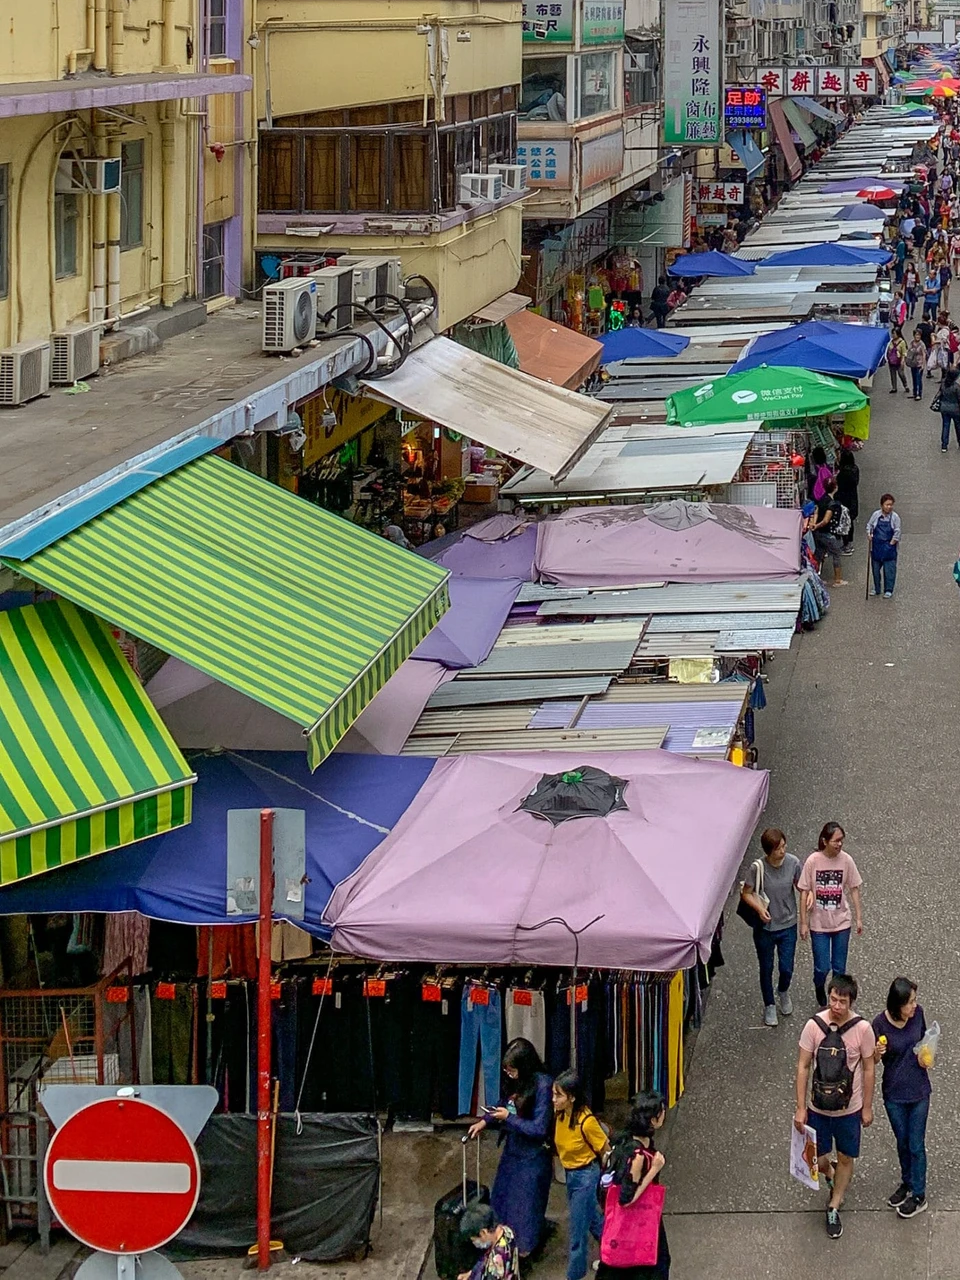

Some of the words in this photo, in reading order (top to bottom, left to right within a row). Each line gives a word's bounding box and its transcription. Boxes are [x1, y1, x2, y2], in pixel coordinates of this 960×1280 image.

[691, 34, 711, 97] 永興隆
[726, 91, 761, 106] 足跡
[760, 385, 802, 397] 微信支付
